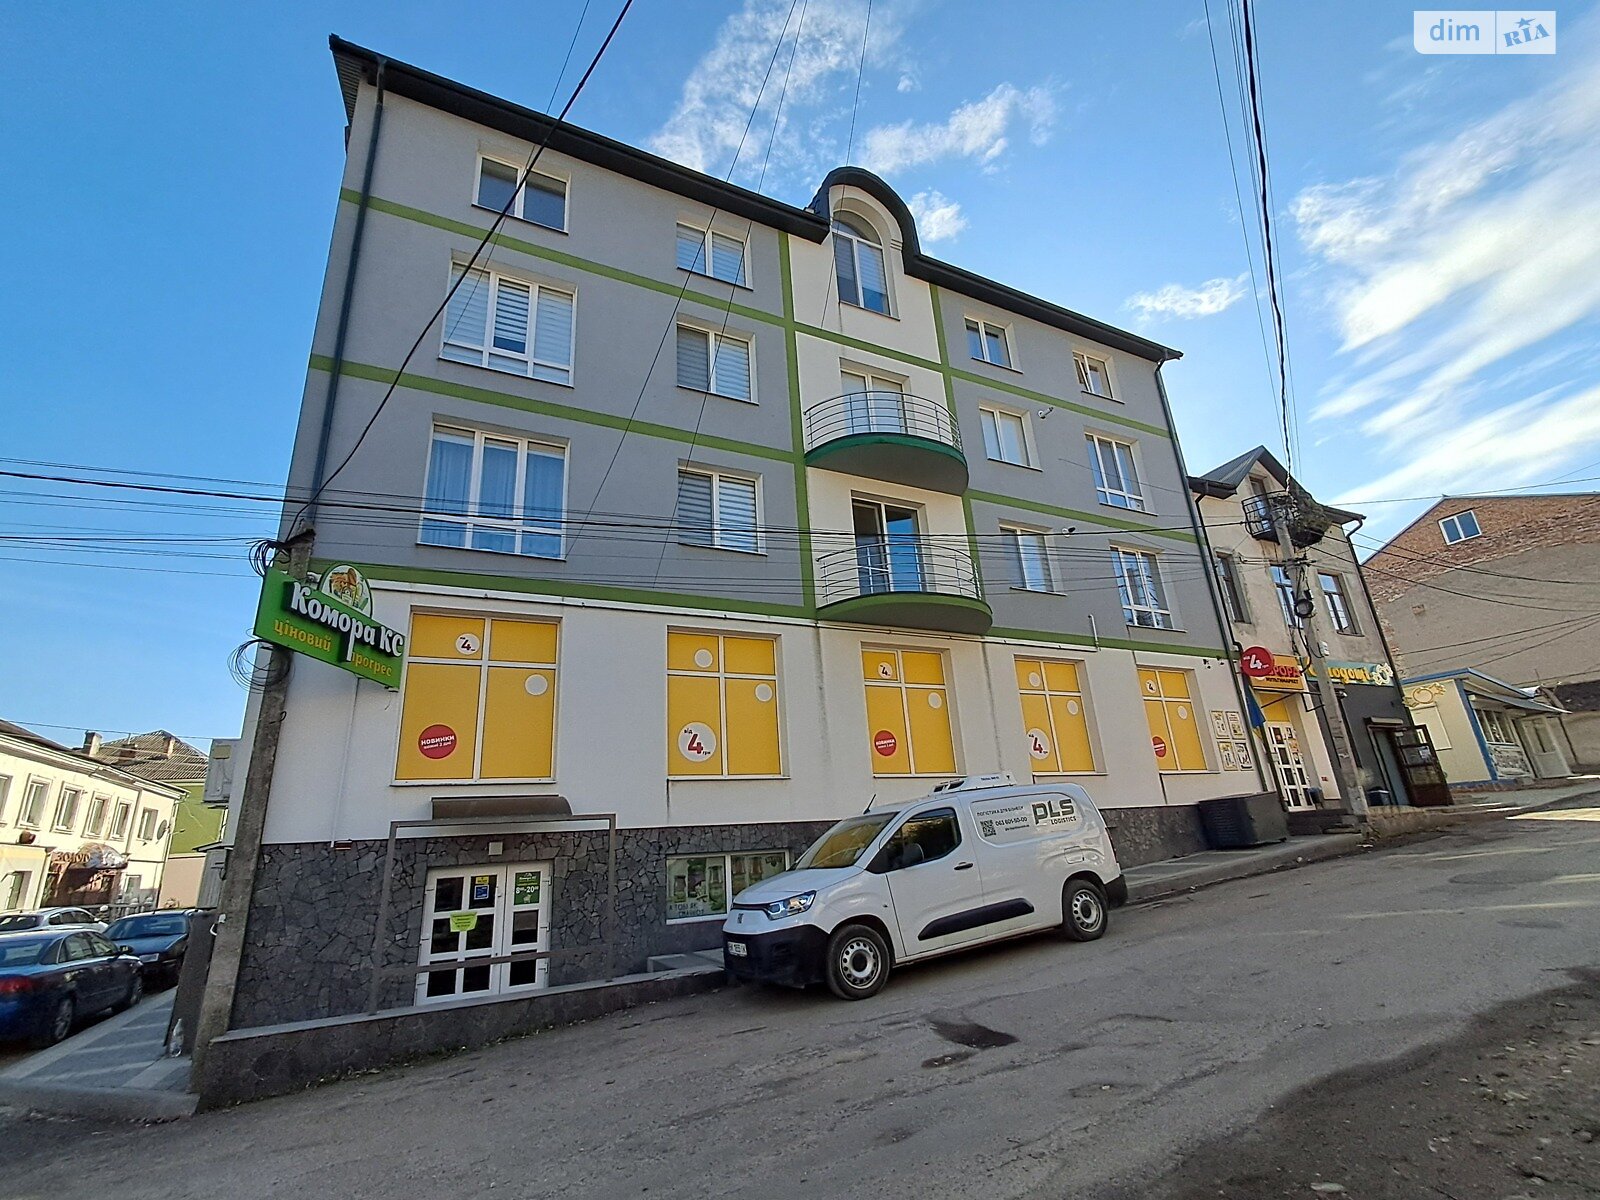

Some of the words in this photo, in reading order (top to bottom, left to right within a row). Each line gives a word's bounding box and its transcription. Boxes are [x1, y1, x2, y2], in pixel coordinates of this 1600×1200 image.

[290, 581, 375, 662] Комора
[380, 626, 404, 657] КС
[274, 618, 332, 652] ціновий
[1250, 654, 1262, 669] 4
[688, 733, 703, 754] 4
[1033, 736, 1043, 753] 4
[1031, 799, 1075, 825] PLS
[1050, 815, 1077, 825] LOGISTICS
